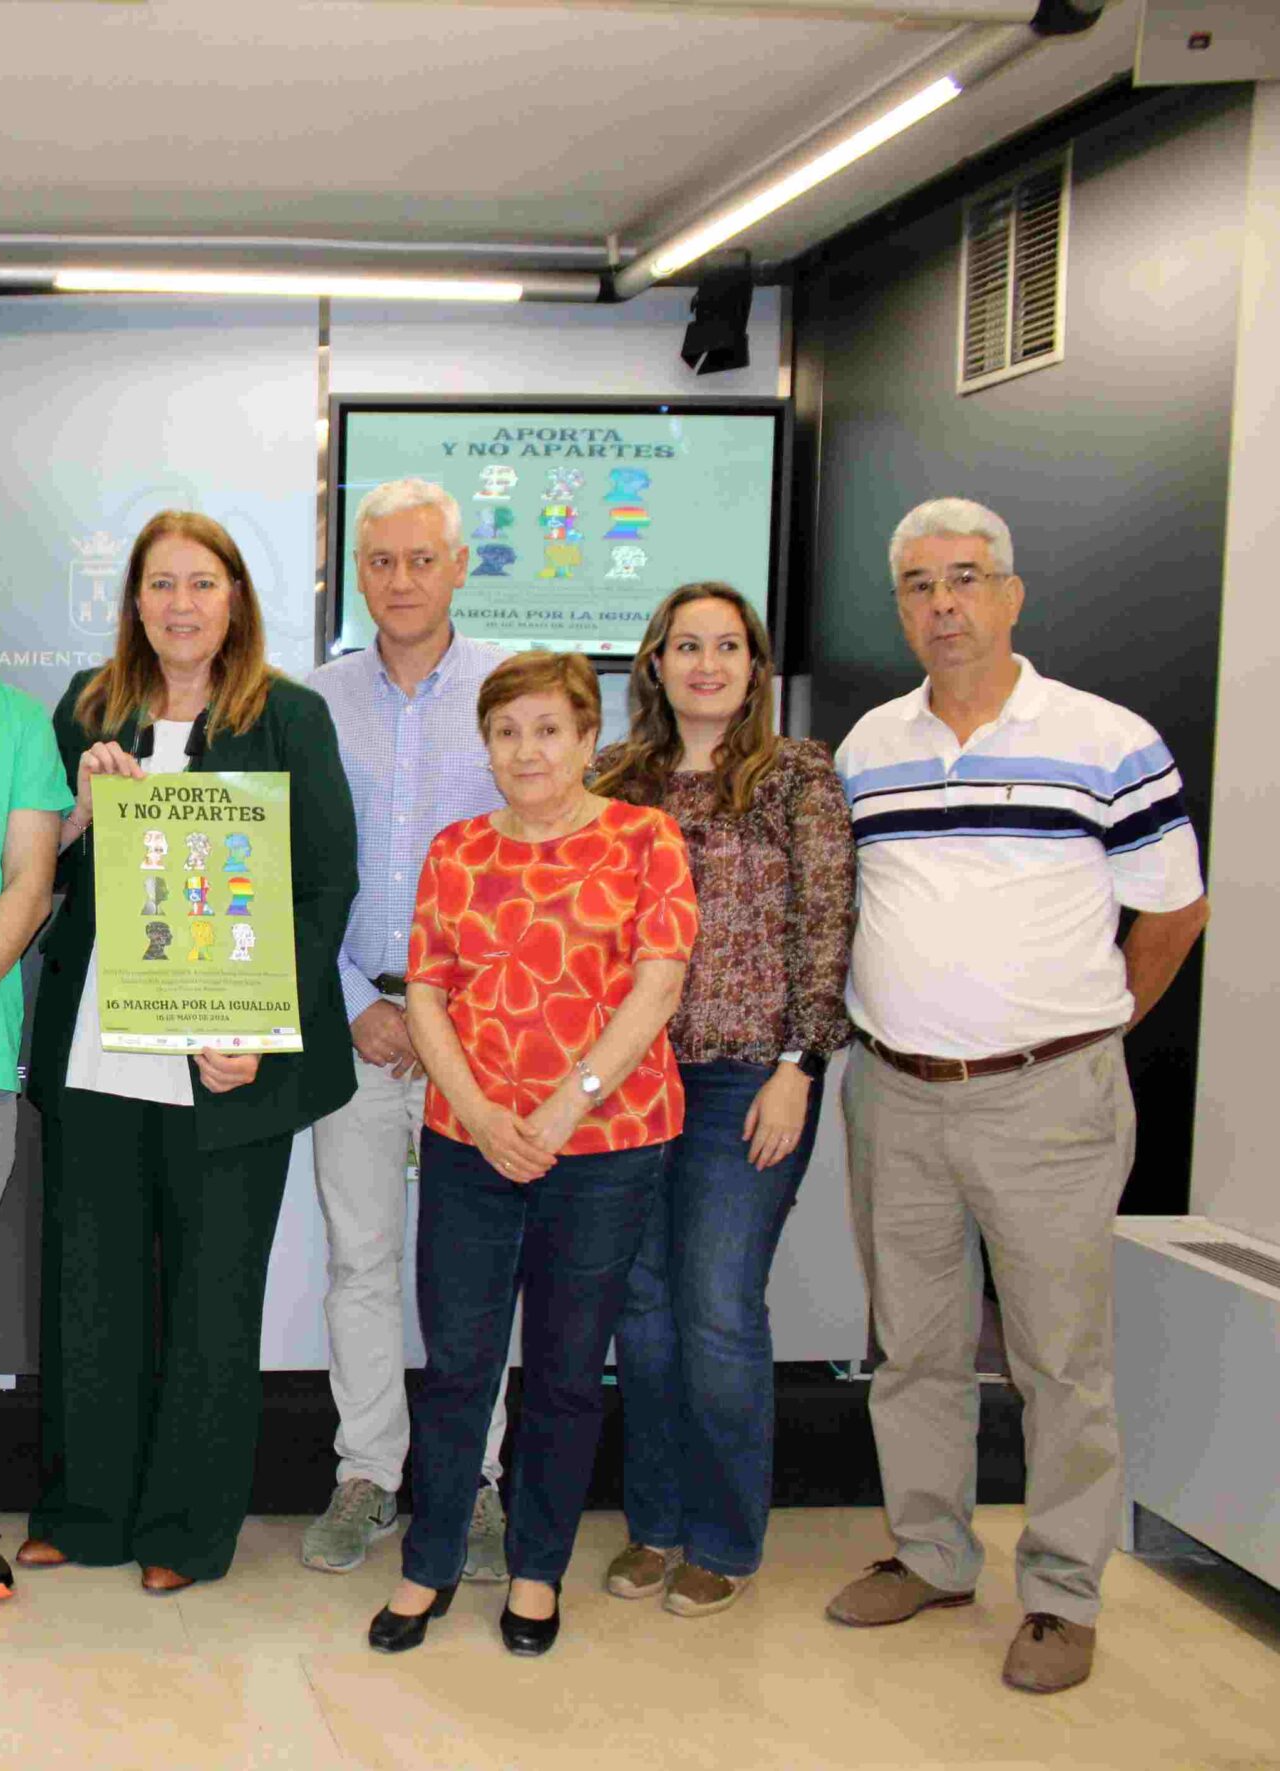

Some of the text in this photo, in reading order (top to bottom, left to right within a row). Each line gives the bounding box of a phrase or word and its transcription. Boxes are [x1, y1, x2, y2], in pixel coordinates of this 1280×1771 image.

[493, 427, 622, 442] APORTA
[442, 441, 675, 458] Y NO APARTES
[449, 608, 519, 620] ARCHA
[526, 610, 564, 621] POR
[570, 611, 593, 621] LA
[150, 786, 232, 804] APORTA
[118, 802, 265, 822] Y NO APARTES
[106, 1000, 291, 1012] 16 MARCHA POR LA IGUALDAD
[177, 1014, 197, 1022] MAYO
